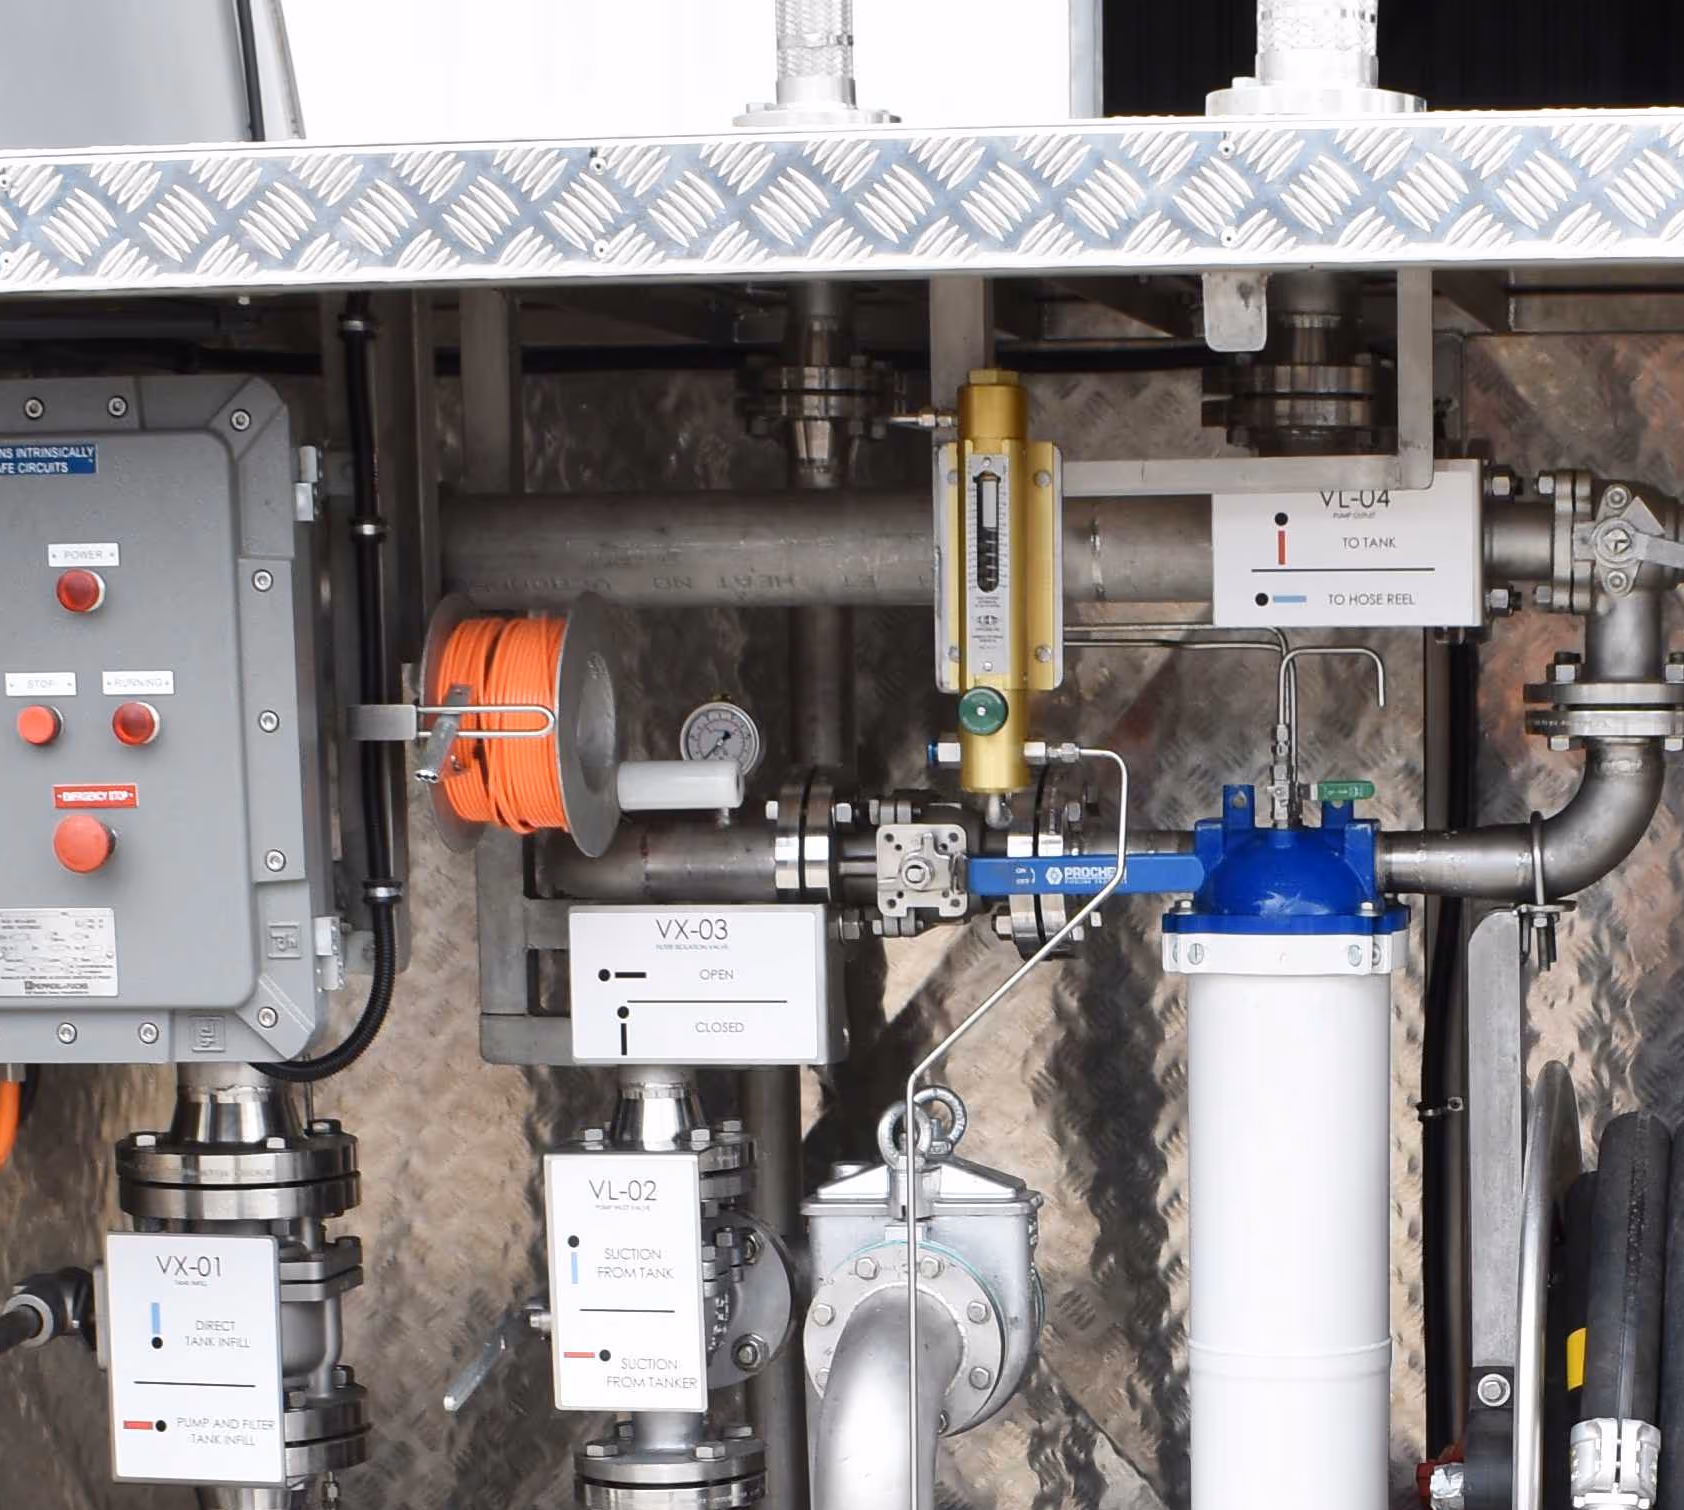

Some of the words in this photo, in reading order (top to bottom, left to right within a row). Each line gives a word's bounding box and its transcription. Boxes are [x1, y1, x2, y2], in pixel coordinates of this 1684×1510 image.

[16, 446, 94, 459] INTRINSICALLY
[17, 462, 69, 474] CIRCUITS
[1320, 489, 1391, 509] VL-04
[1342, 536, 1360, 549] TO
[1362, 536, 1398, 549] TANK
[63, 549, 104, 560] POWER
[1328, 593, 1345, 606] TO
[1349, 593, 1383, 606] HOSE
[1387, 593, 1416, 606] REEL
[26, 679, 56, 690] STOP
[114, 678, 164, 688] RUNNING
[62, 791, 108, 802] EMERGENCY
[108, 790, 129, 801] STOP
[1064, 866, 1127, 879] PROCHE
[655, 918, 729, 941] VX-03
[699, 968, 735, 981] OPEN
[695, 1021, 745, 1034] CLOSED
[588, 1179, 658, 1201] VL-02
[603, 1248, 662, 1261] SUCTION
[155, 1255, 222, 1277] VX-01
[597, 1266, 637, 1279] FROM
[639, 1267, 675, 1280] TANK
[194, 1320, 236, 1332] DIRECT
[184, 1336, 216, 1348] TANK
[218, 1336, 251, 1349] INFILL
[620, 1358, 678, 1371] SUCTION
[606, 1376, 646, 1389] FROM
[647, 1377, 699, 1390] TANKER
[176, 1417, 210, 1429] PUMP
[213, 1418, 240, 1430] AND
[242, 1419, 276, 1431] FILTER
[191, 1433, 222, 1446] TANK
[224, 1434, 256, 1447] INFILL
